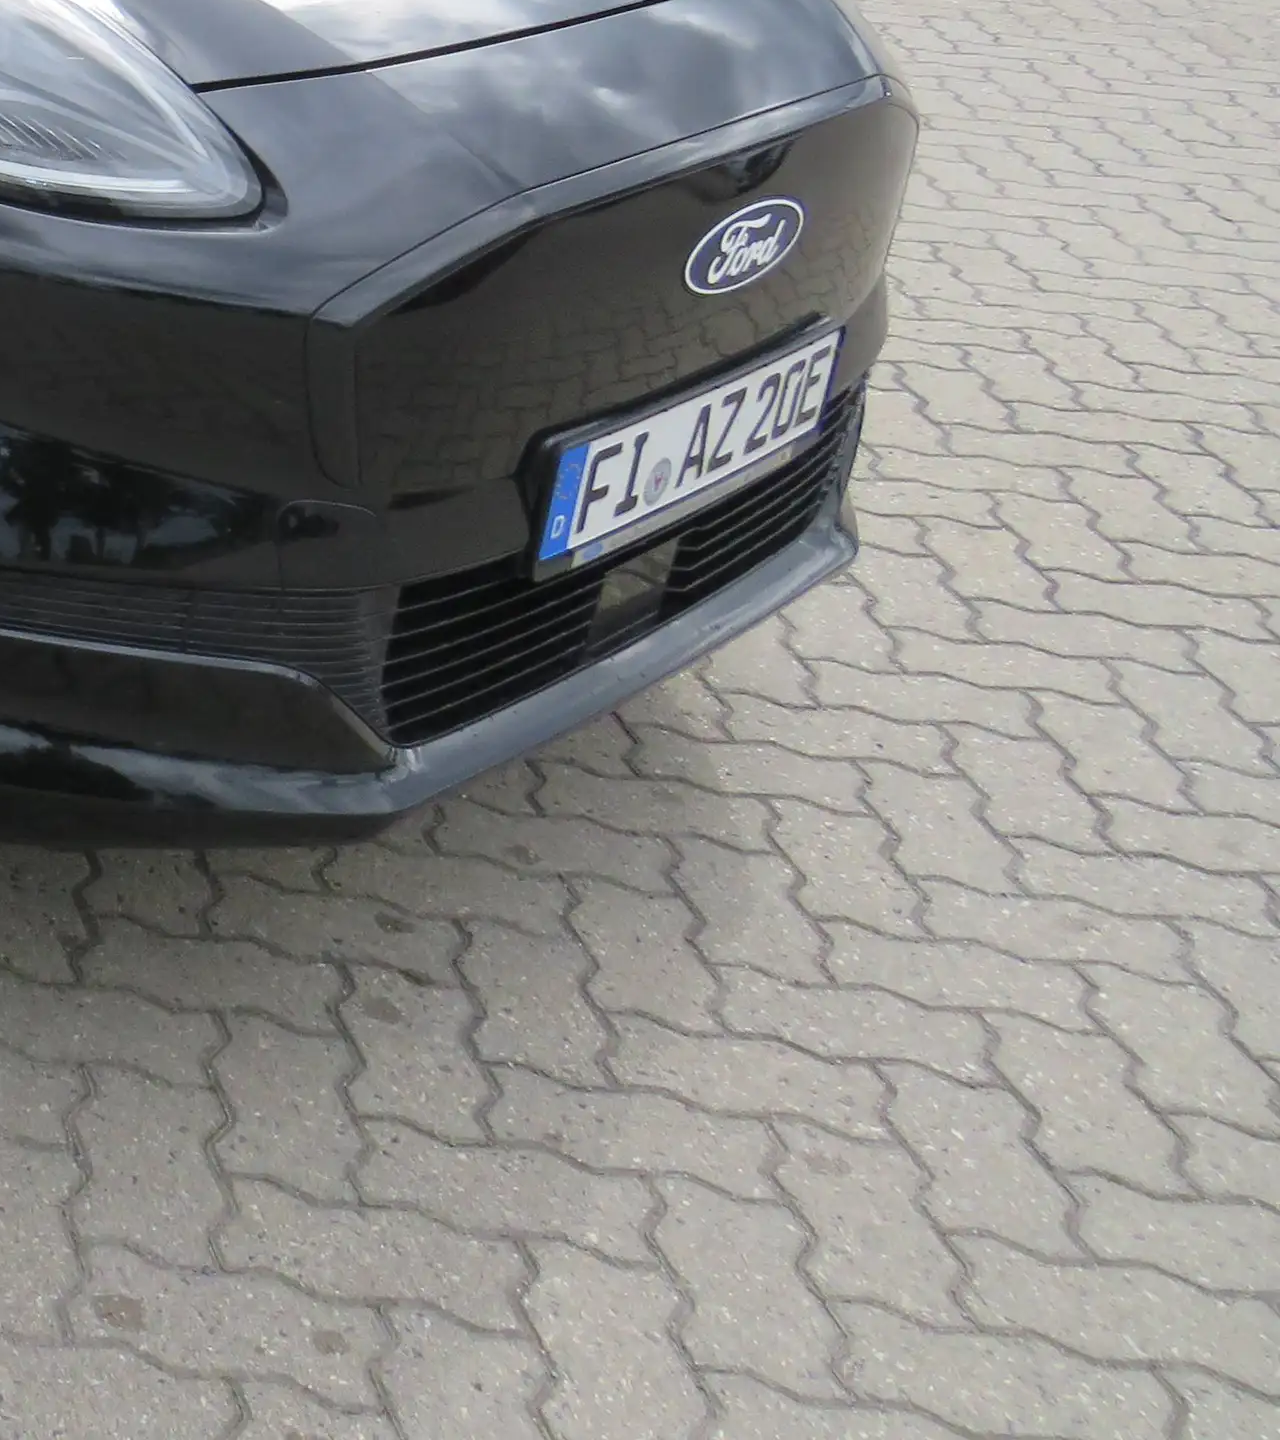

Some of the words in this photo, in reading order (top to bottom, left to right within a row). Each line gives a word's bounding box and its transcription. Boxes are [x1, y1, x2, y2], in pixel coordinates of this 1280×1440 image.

[707, 213, 786, 285] Ford
[550, 515, 565, 539] D
[575, 431, 649, 534] FI
